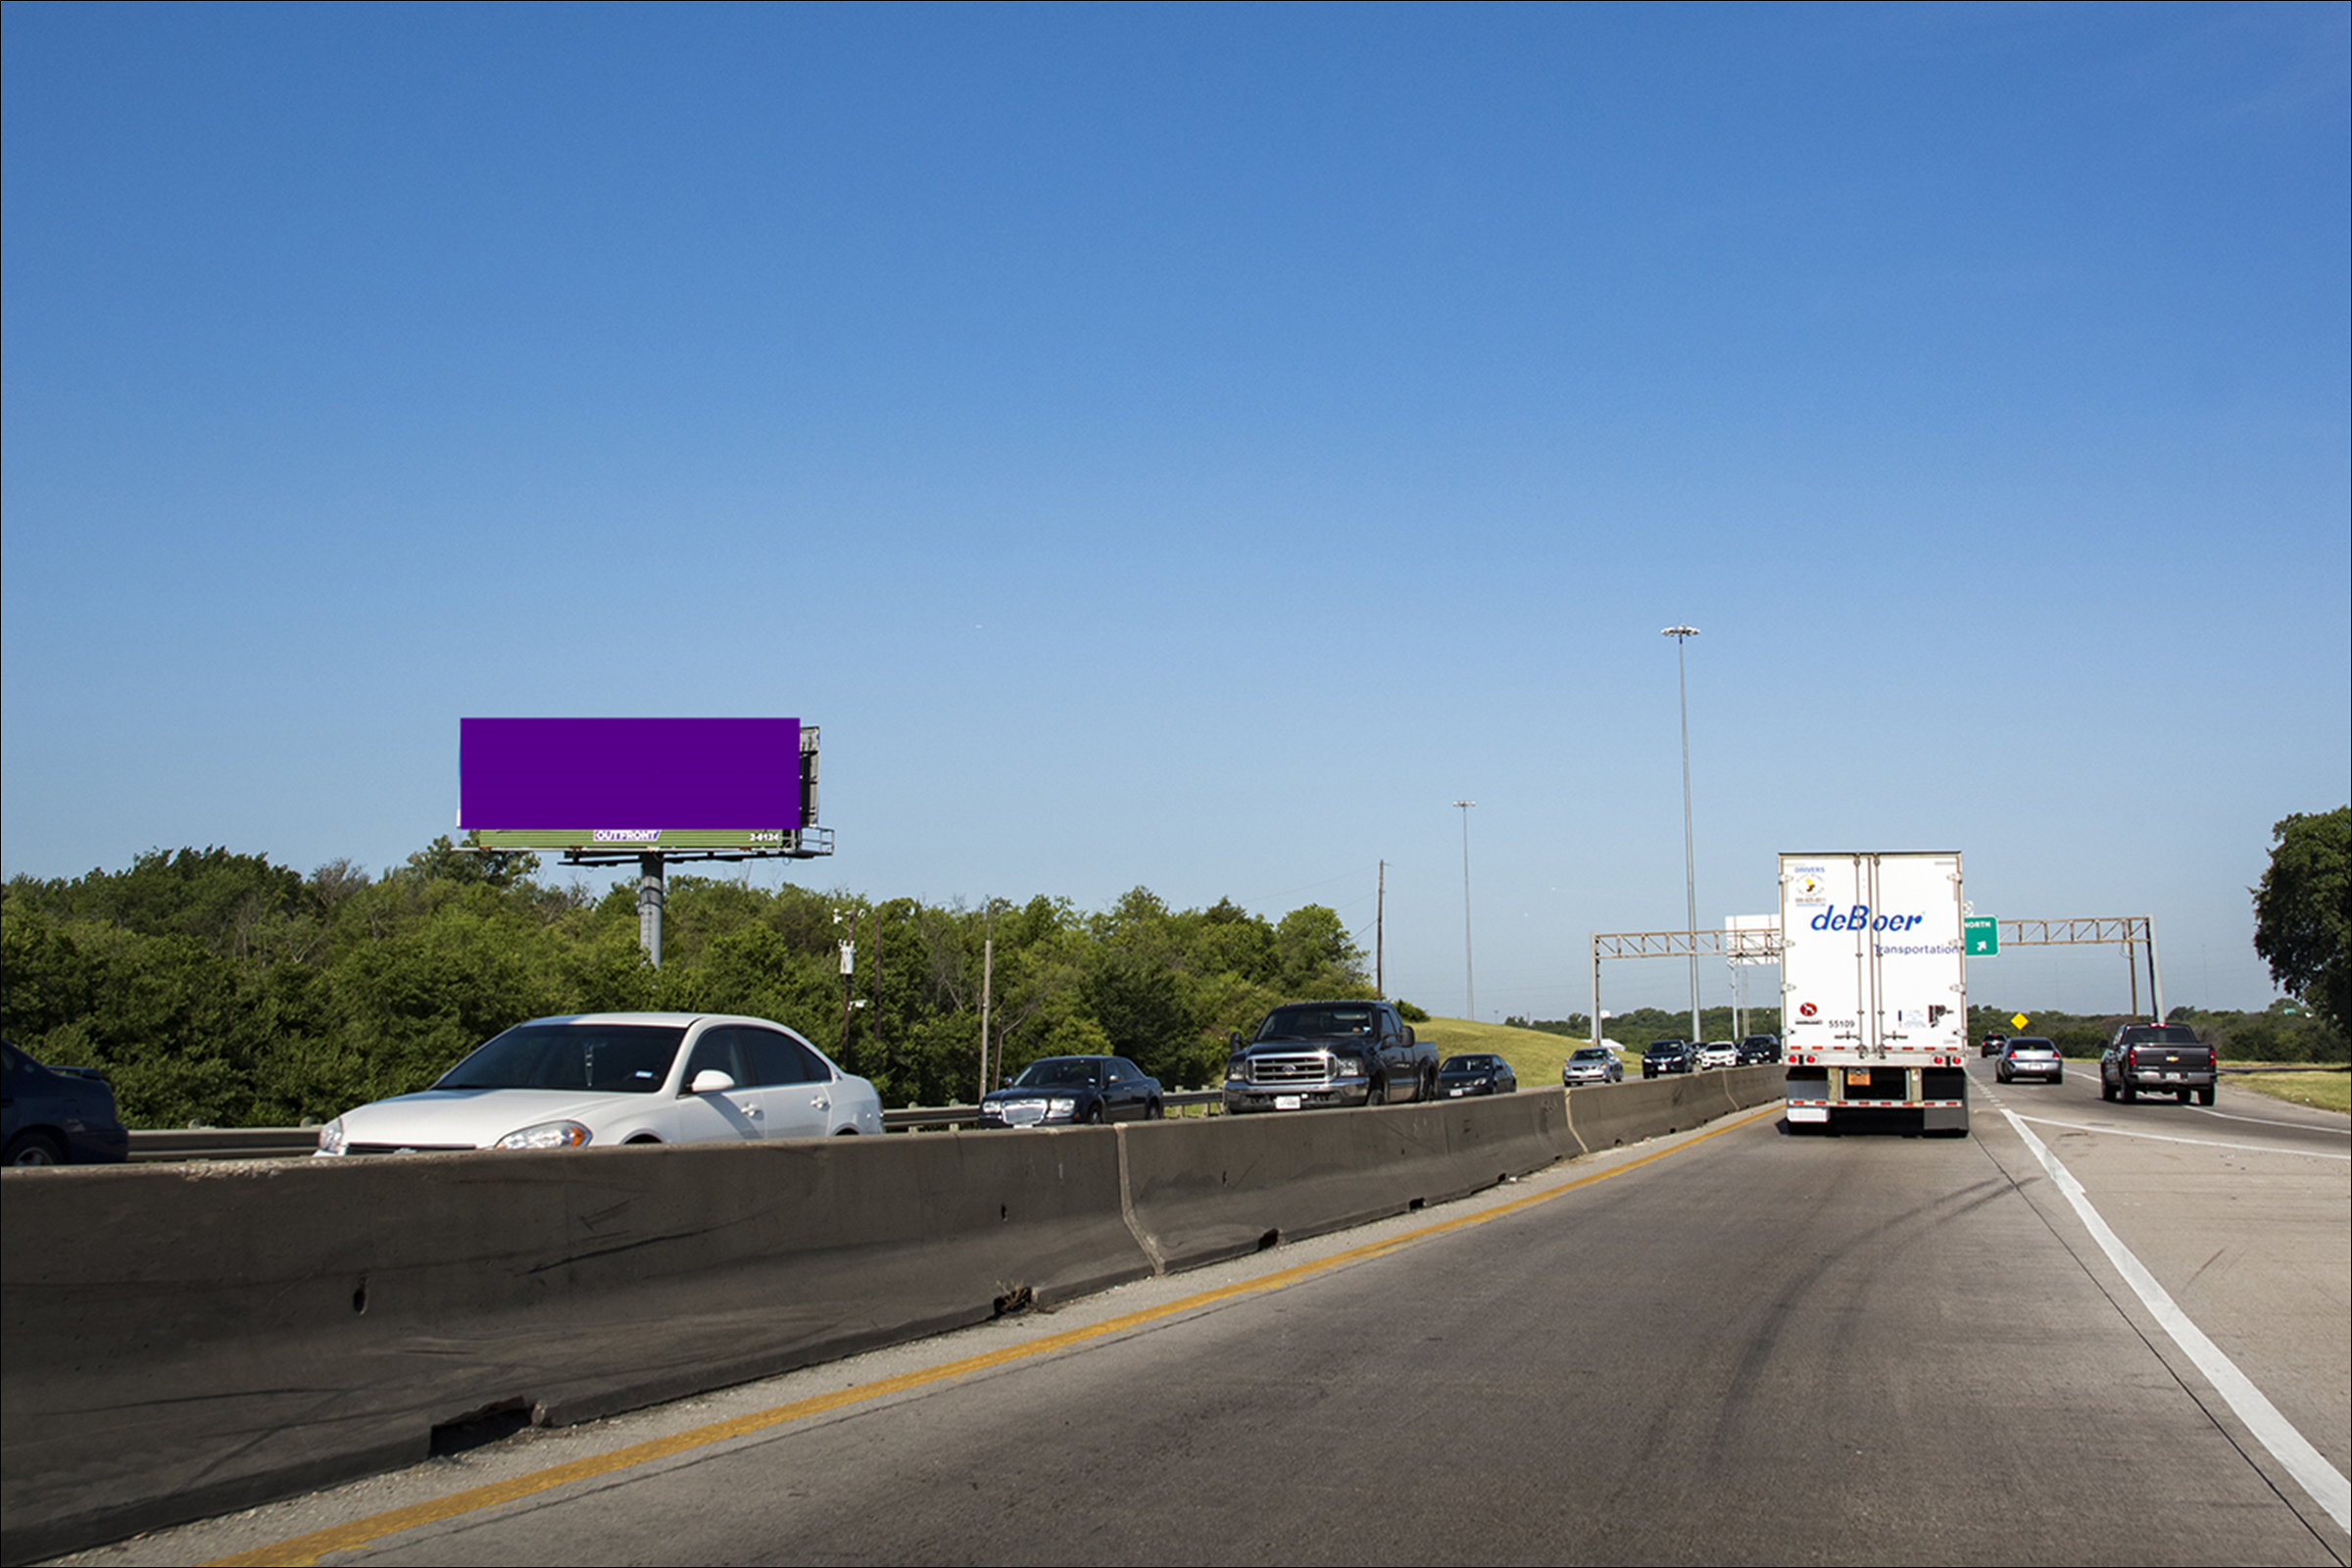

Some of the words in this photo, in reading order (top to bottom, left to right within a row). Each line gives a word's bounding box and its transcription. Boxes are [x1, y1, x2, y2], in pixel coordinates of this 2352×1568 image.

[596, 829, 657, 841] OUTFRONT
[1810, 905, 1923, 932] deBoer
[1873, 944, 1960, 956] Transportation
[1829, 1019, 1855, 1028] 55109
